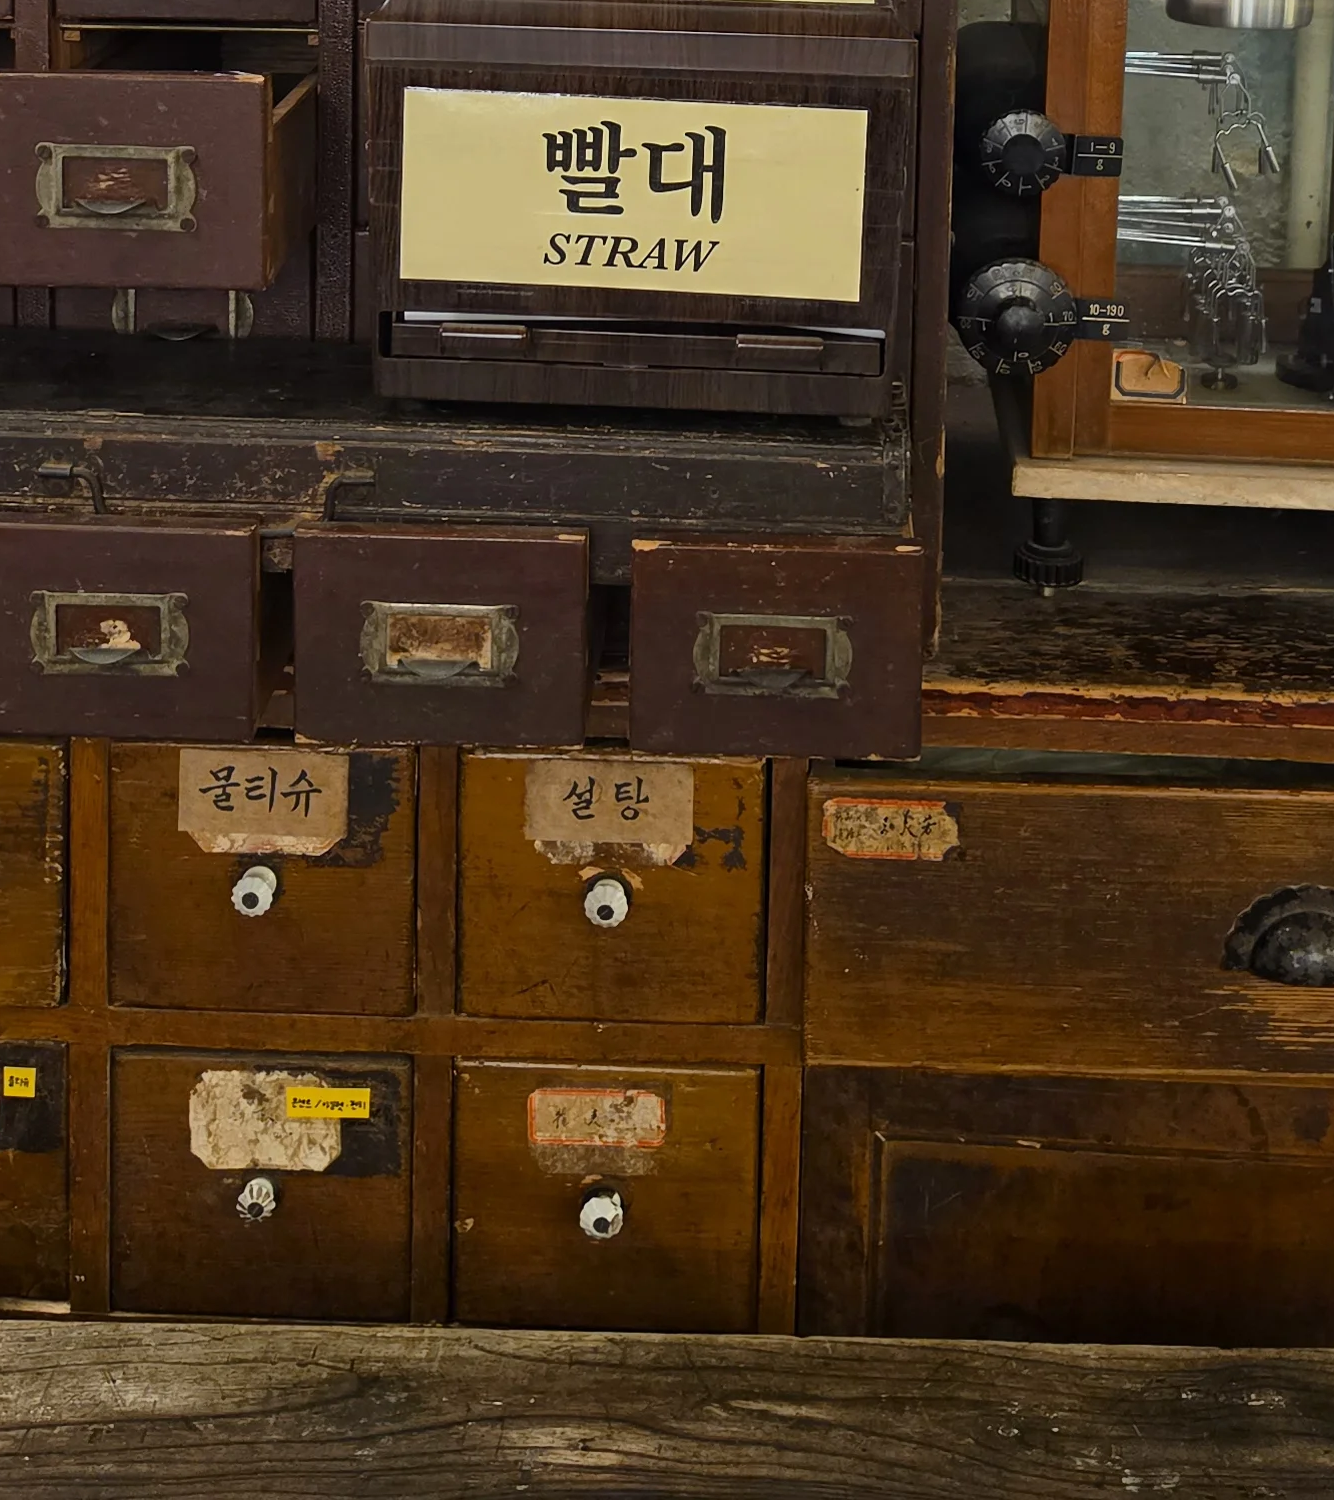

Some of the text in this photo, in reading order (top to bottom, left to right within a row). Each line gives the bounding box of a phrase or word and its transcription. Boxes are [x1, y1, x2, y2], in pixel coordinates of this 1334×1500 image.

[542, 120, 727, 223] 빨대
[543, 232, 719, 273] STRAW
[1089, 304, 1124, 316] 10-190
[199, 765, 322, 818] 물티슈
[563, 776, 650, 820] 설탕
